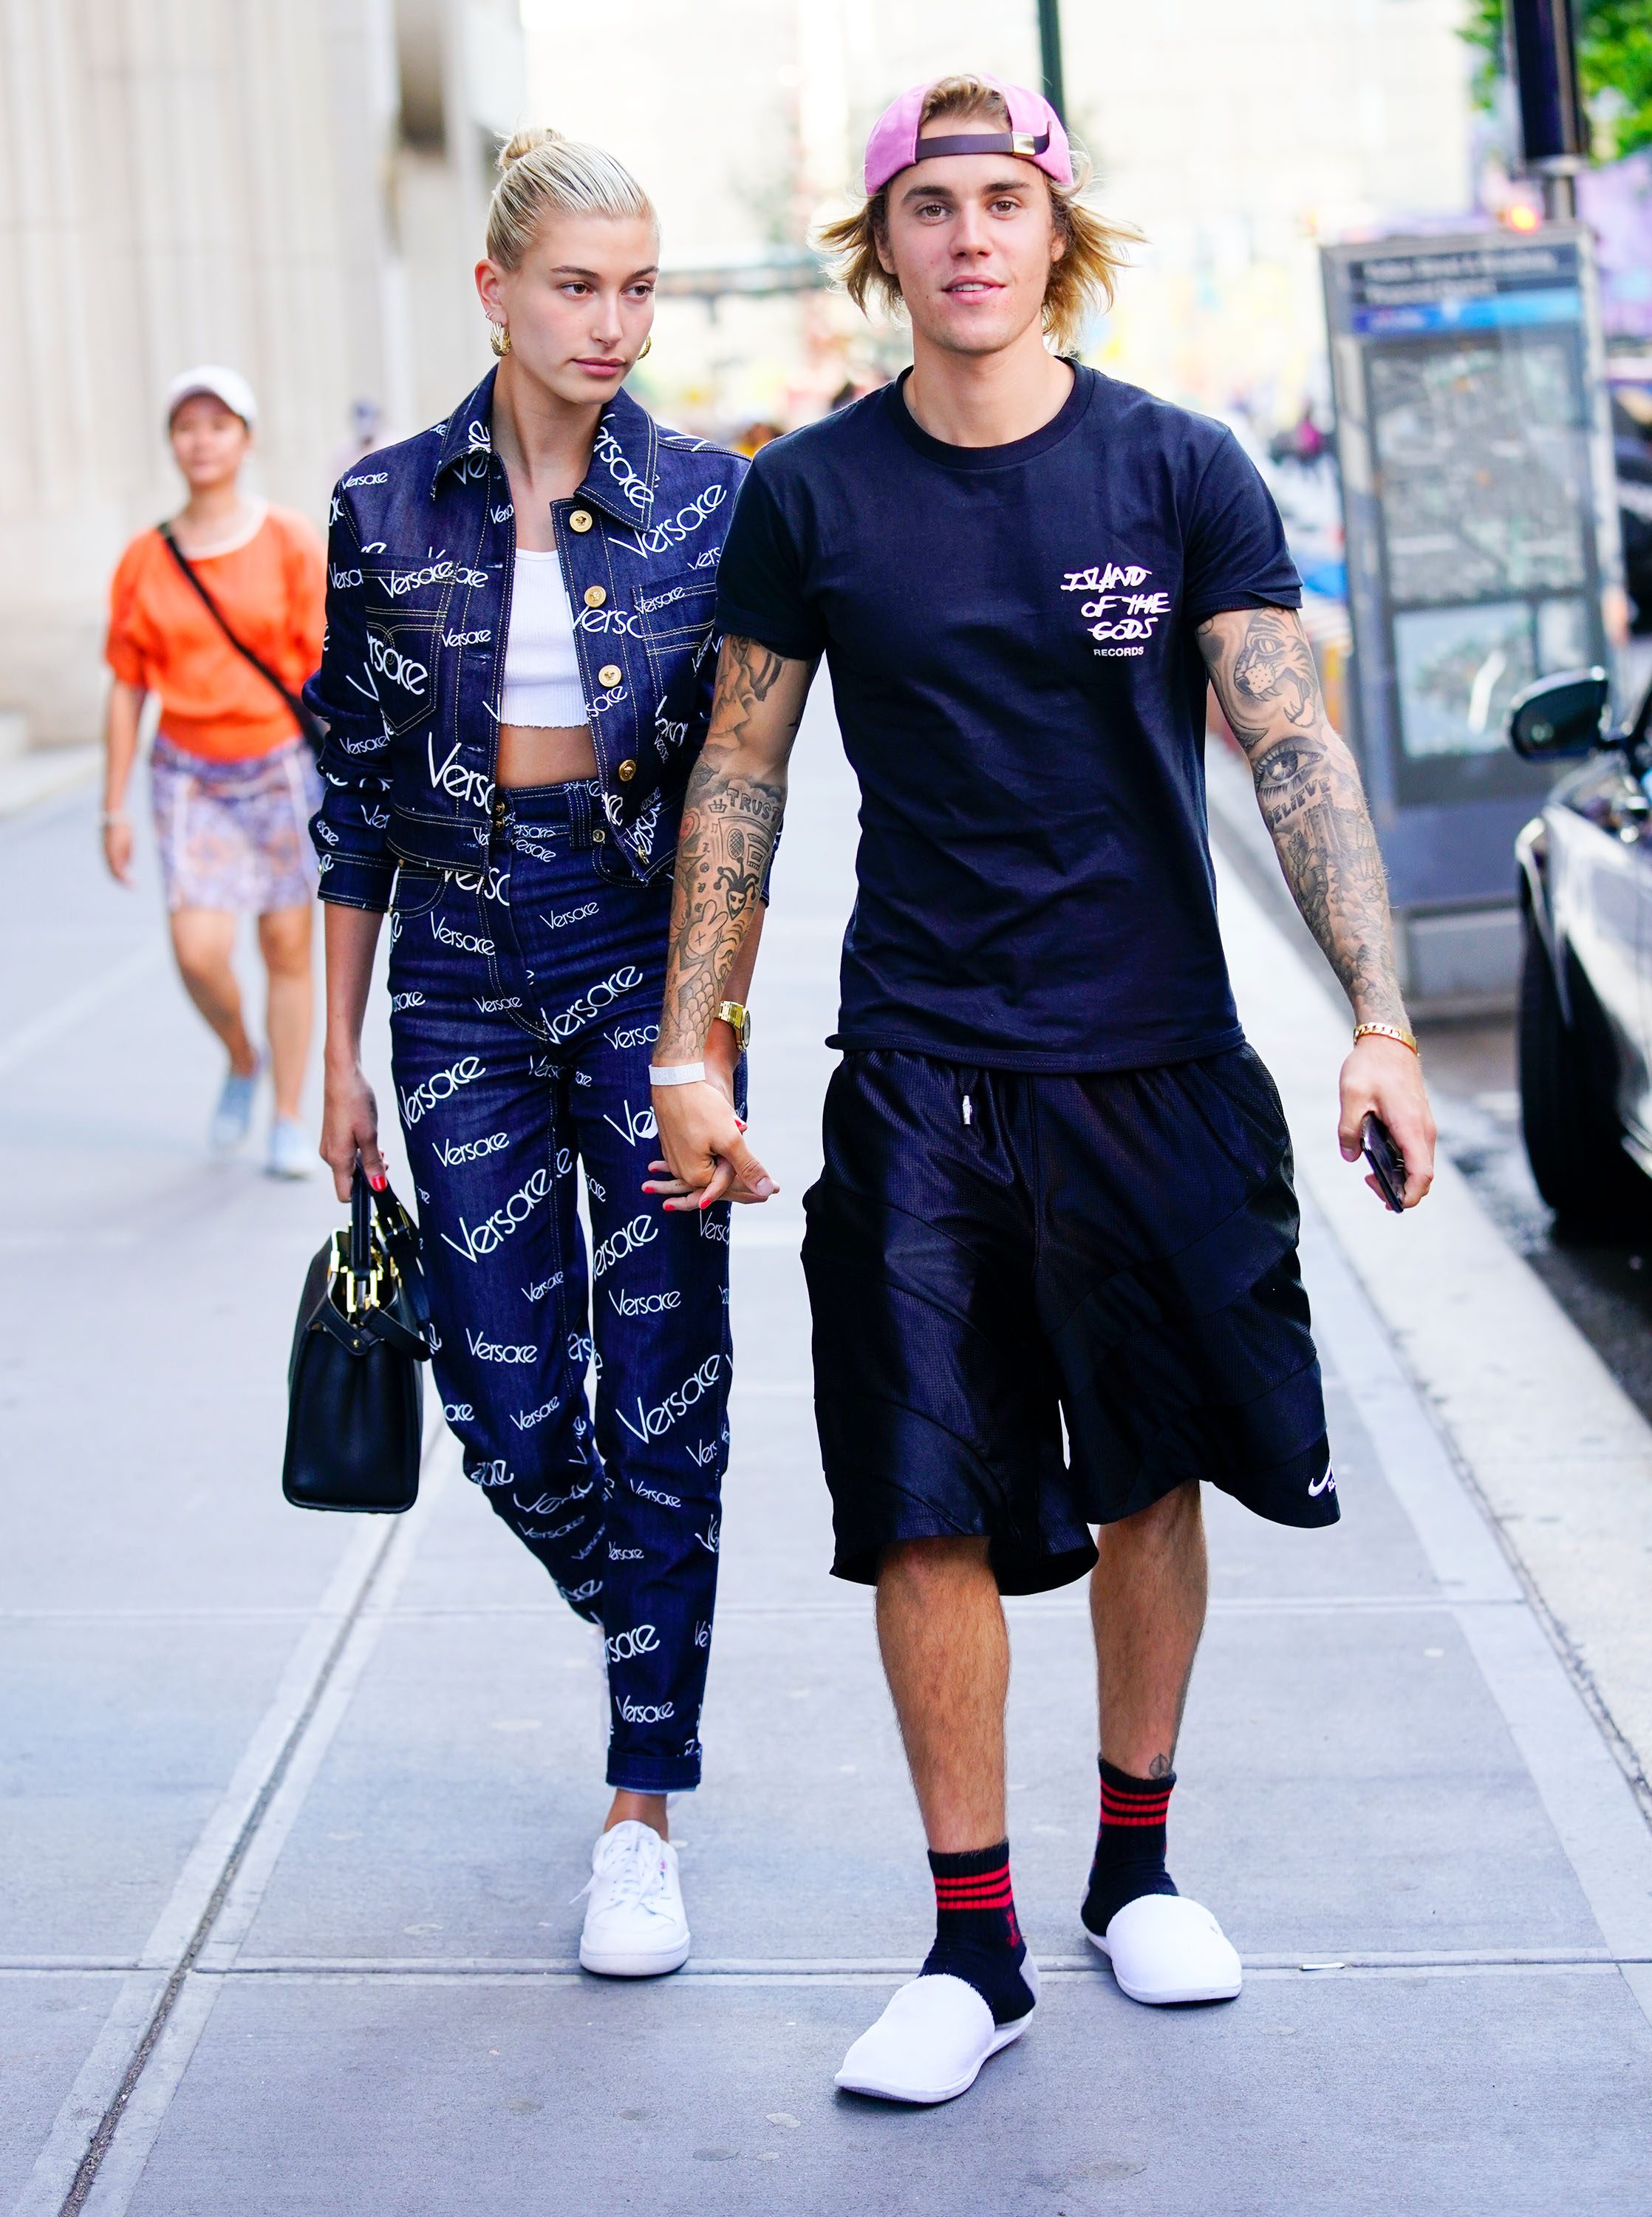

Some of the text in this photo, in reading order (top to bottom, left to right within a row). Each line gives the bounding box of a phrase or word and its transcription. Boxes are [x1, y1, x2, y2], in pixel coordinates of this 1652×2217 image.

[341, 471, 389, 490] Versace
[608, 485, 727, 559] Versace
[378, 561, 454, 599] Versace
[634, 586, 686, 615] Versace
[1081, 593, 1172, 618] OF THE
[442, 628, 491, 649] Versace
[1087, 617, 1158, 641] GODS
[1093, 647, 1144, 657] RECORDS
[339, 735, 389, 755] Versace
[726, 787, 781, 823] TRUST
[539, 902, 600, 930] Versace
[430, 911, 496, 956] Versace
[472, 995, 523, 1013] Versace
[398, 1055, 486, 1131] Versace
[431, 1131, 511, 1168] Versace
[440, 1168, 553, 1264] Versace
[592, 1214, 659, 1282] ersace
[521, 1270, 564, 1303] Versace
[608, 1288, 682, 1316] Versace
[465, 1327, 538, 1364] Versace
[510, 1395, 560, 1431] Versace
[615, 1354, 720, 1445] Versace
[608, 1540, 645, 1561] Versace
[615, 1695, 675, 1724] Versace
